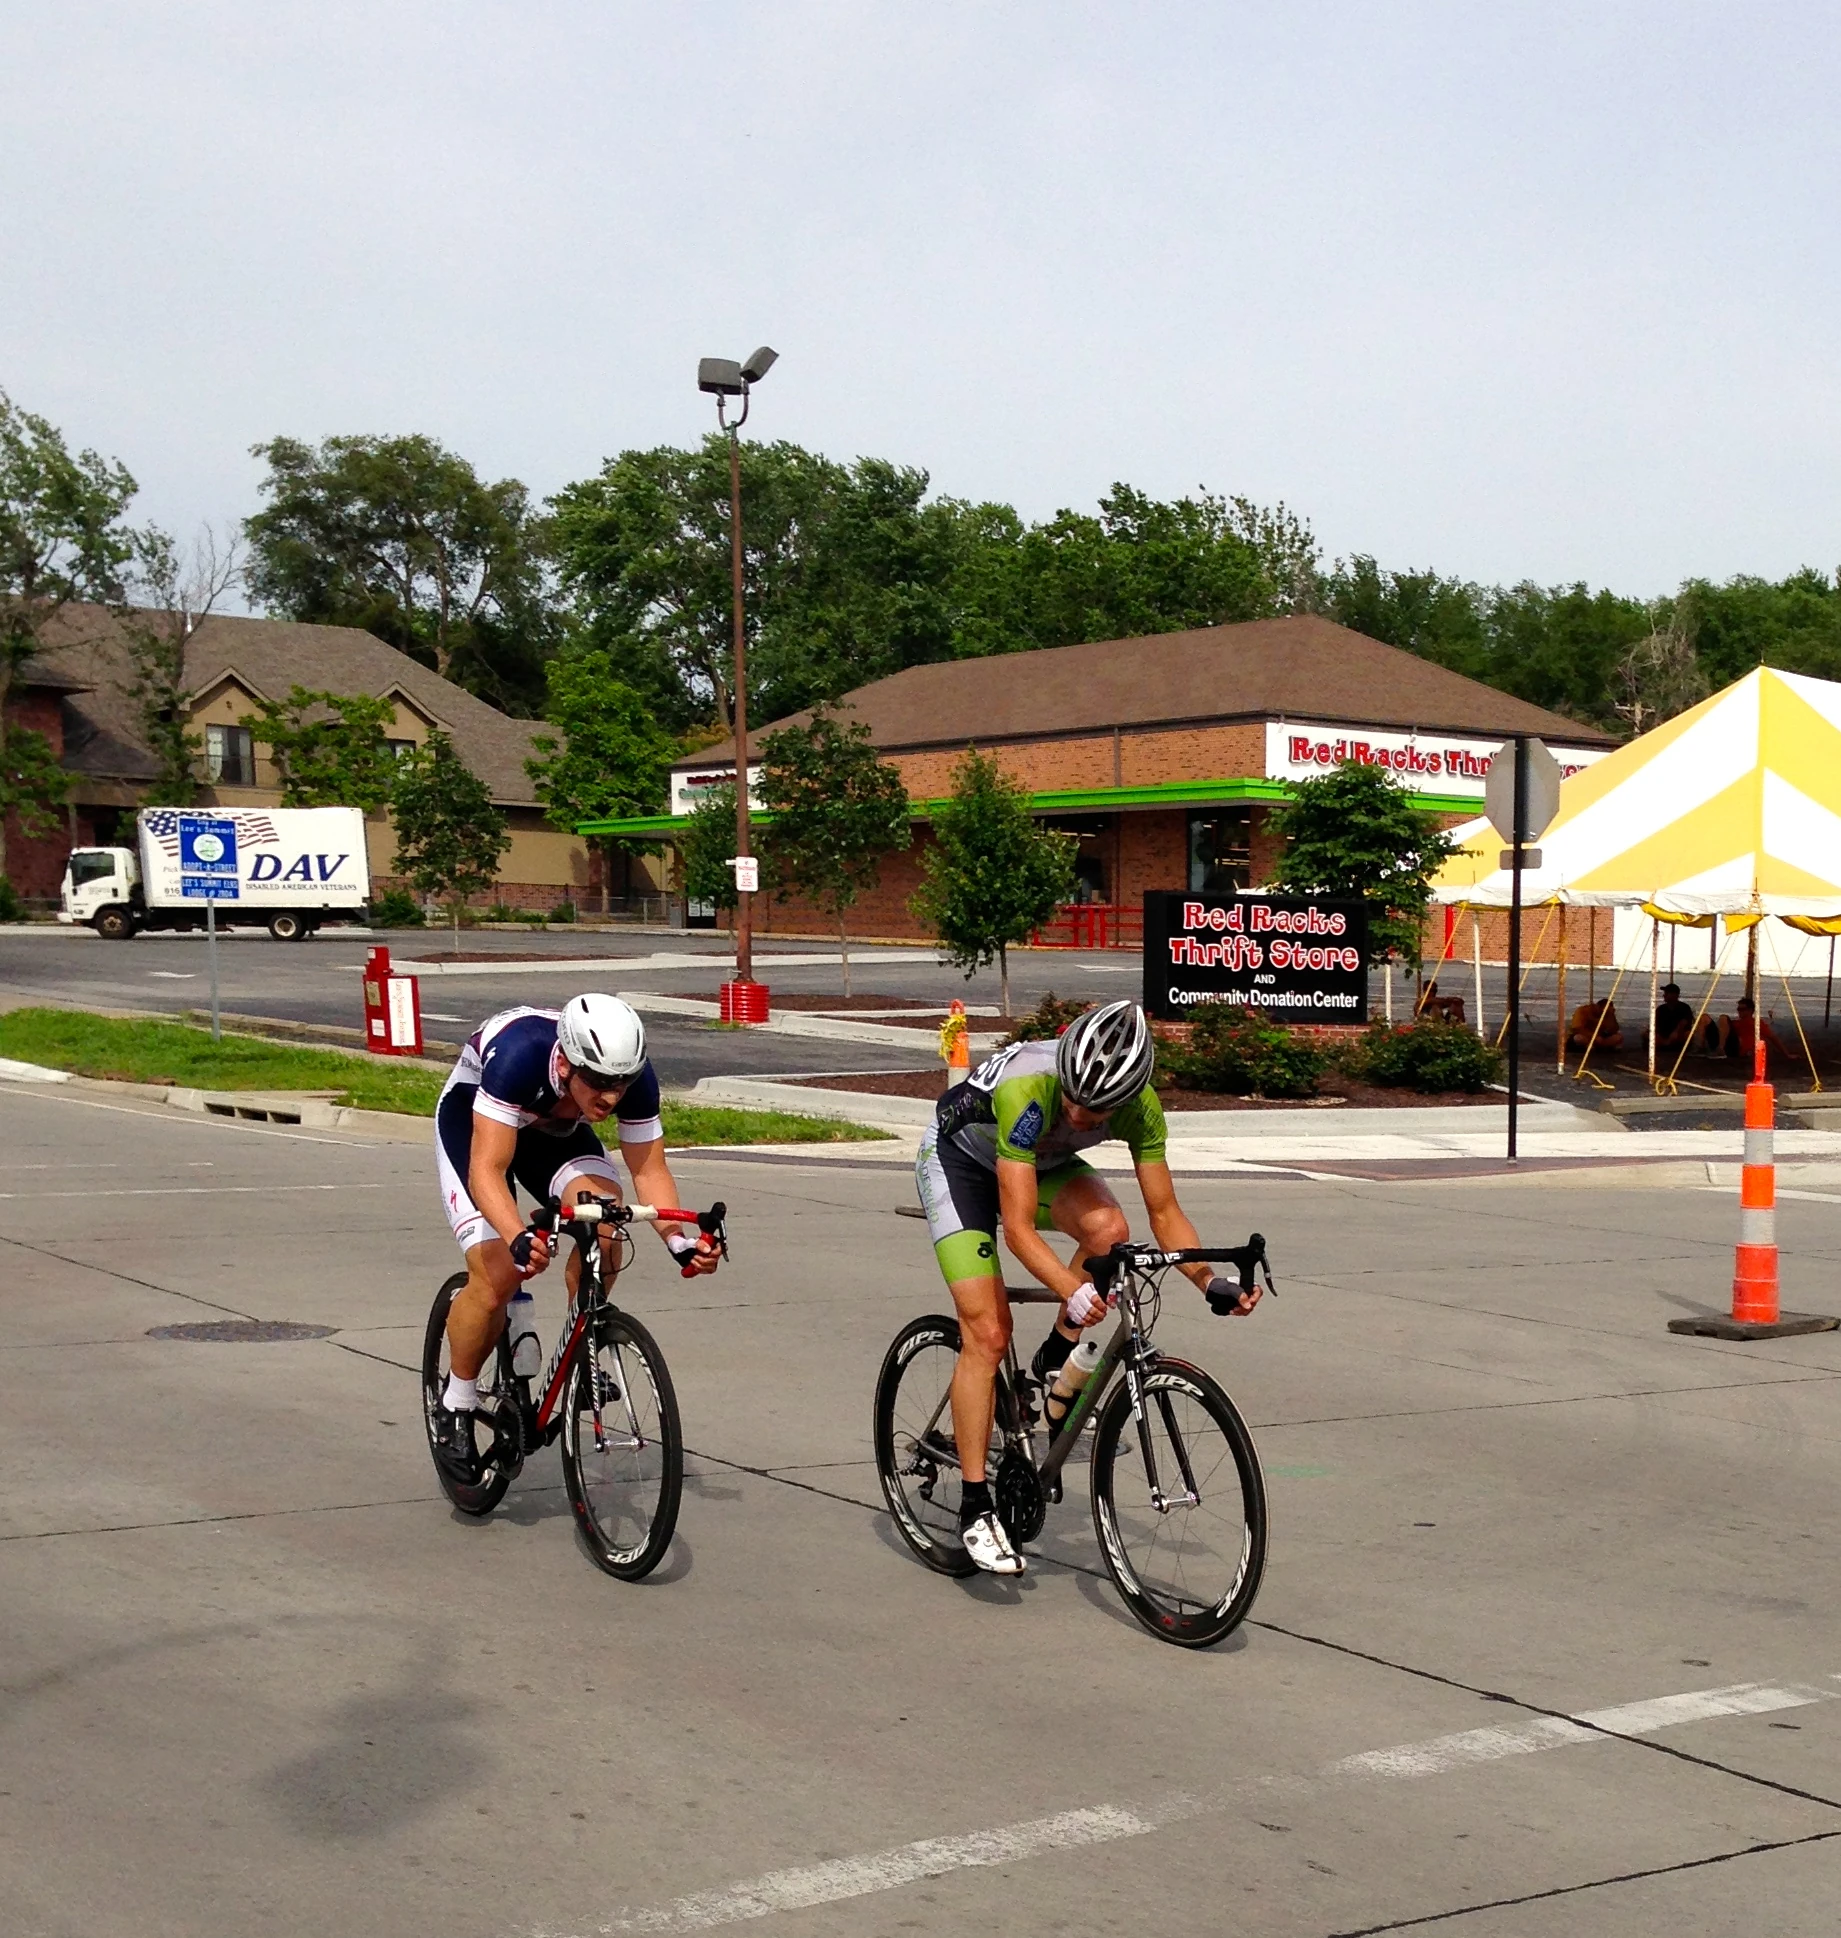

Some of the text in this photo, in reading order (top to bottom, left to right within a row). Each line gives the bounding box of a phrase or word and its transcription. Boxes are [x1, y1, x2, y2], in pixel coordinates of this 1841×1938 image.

[1289, 736, 1500, 779] Red Racks Thr
[247, 853, 350, 881] DAV
[1183, 902, 1346, 935] Red Racks
[1169, 935, 1359, 971] Thrift Store
[1253, 974, 1276, 984] AND
[1250, 989, 1311, 1008] Donation
[1313, 991, 1359, 1008] Center
[897, 1331, 945, 1365] ZIPP
[1143, 1374, 1204, 1397] ZIPP
[606, 1532, 650, 1564] ZIPP
